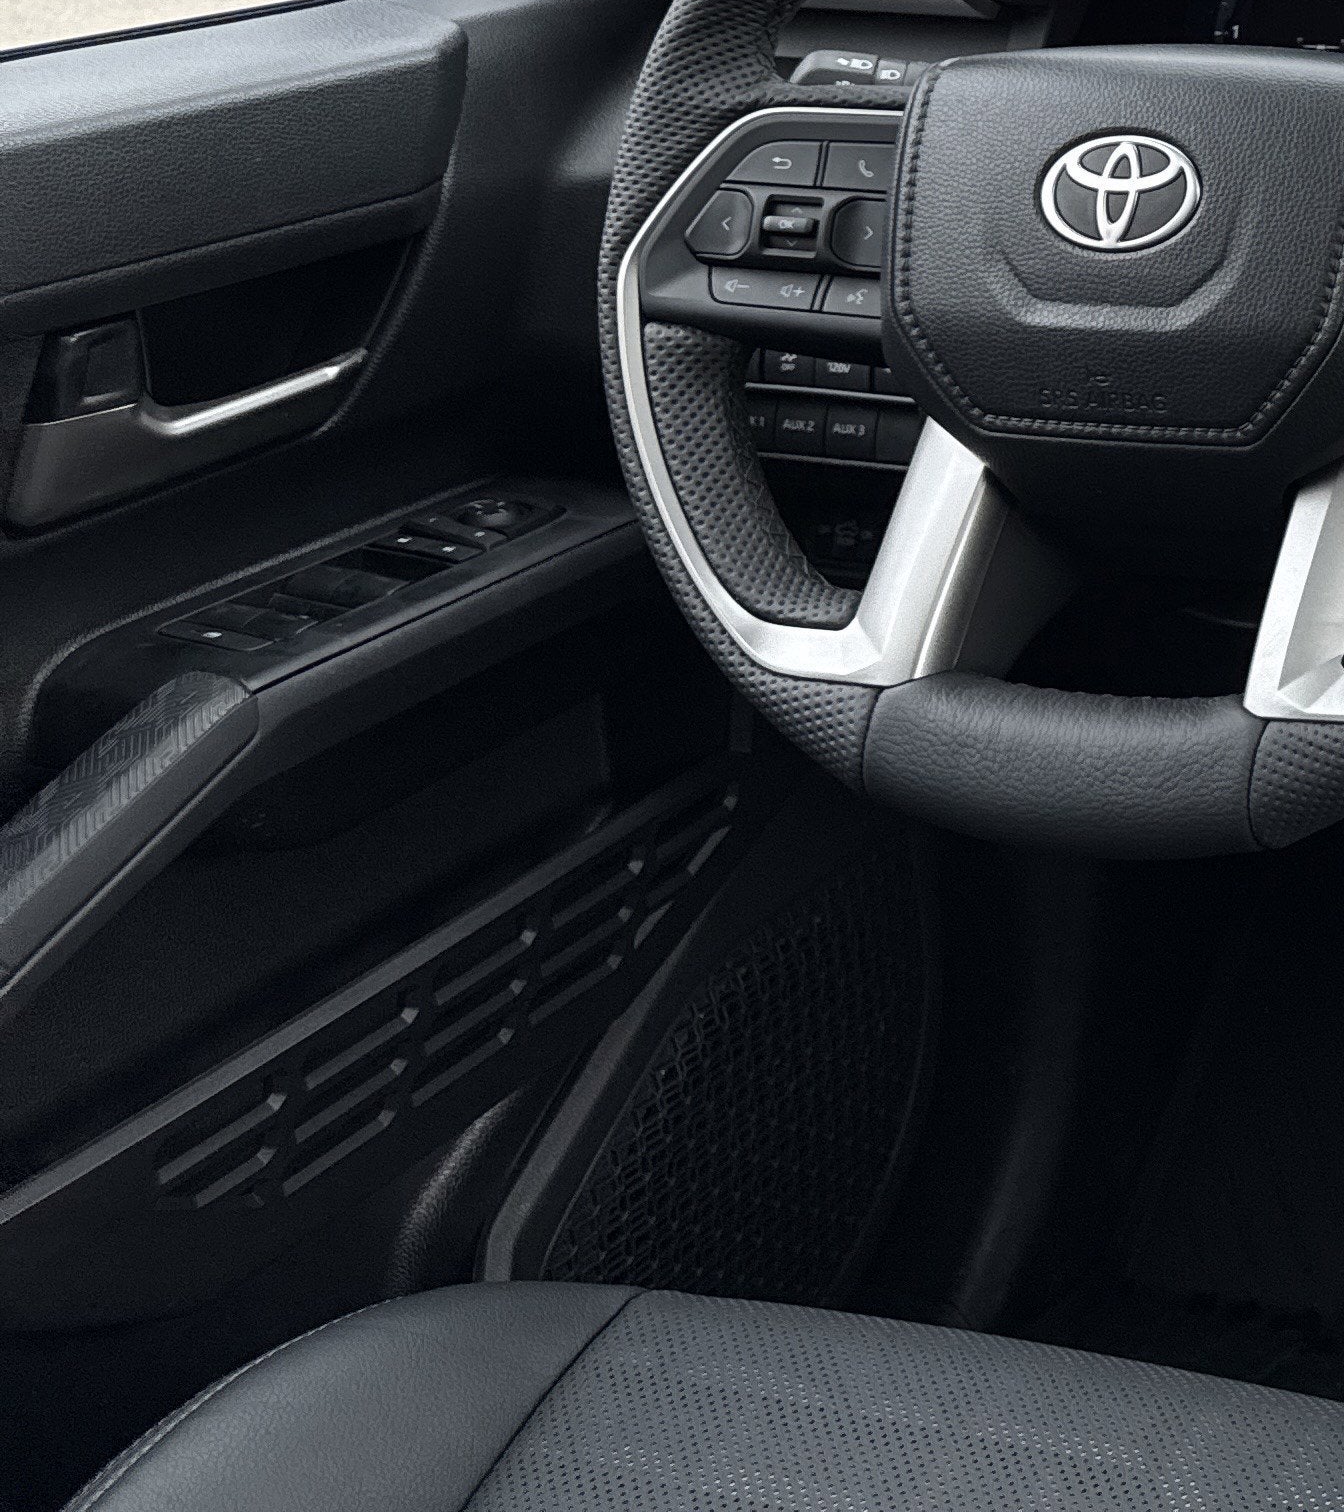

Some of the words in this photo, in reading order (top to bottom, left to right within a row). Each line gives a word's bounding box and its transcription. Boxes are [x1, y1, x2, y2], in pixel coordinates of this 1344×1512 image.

[1232, 24, 1240, 39] 1
[783, 419, 806, 431] AUX
[807, 420, 816, 432] 2
[832, 423, 856, 435] AUX
[858, 425, 867, 437] 3
